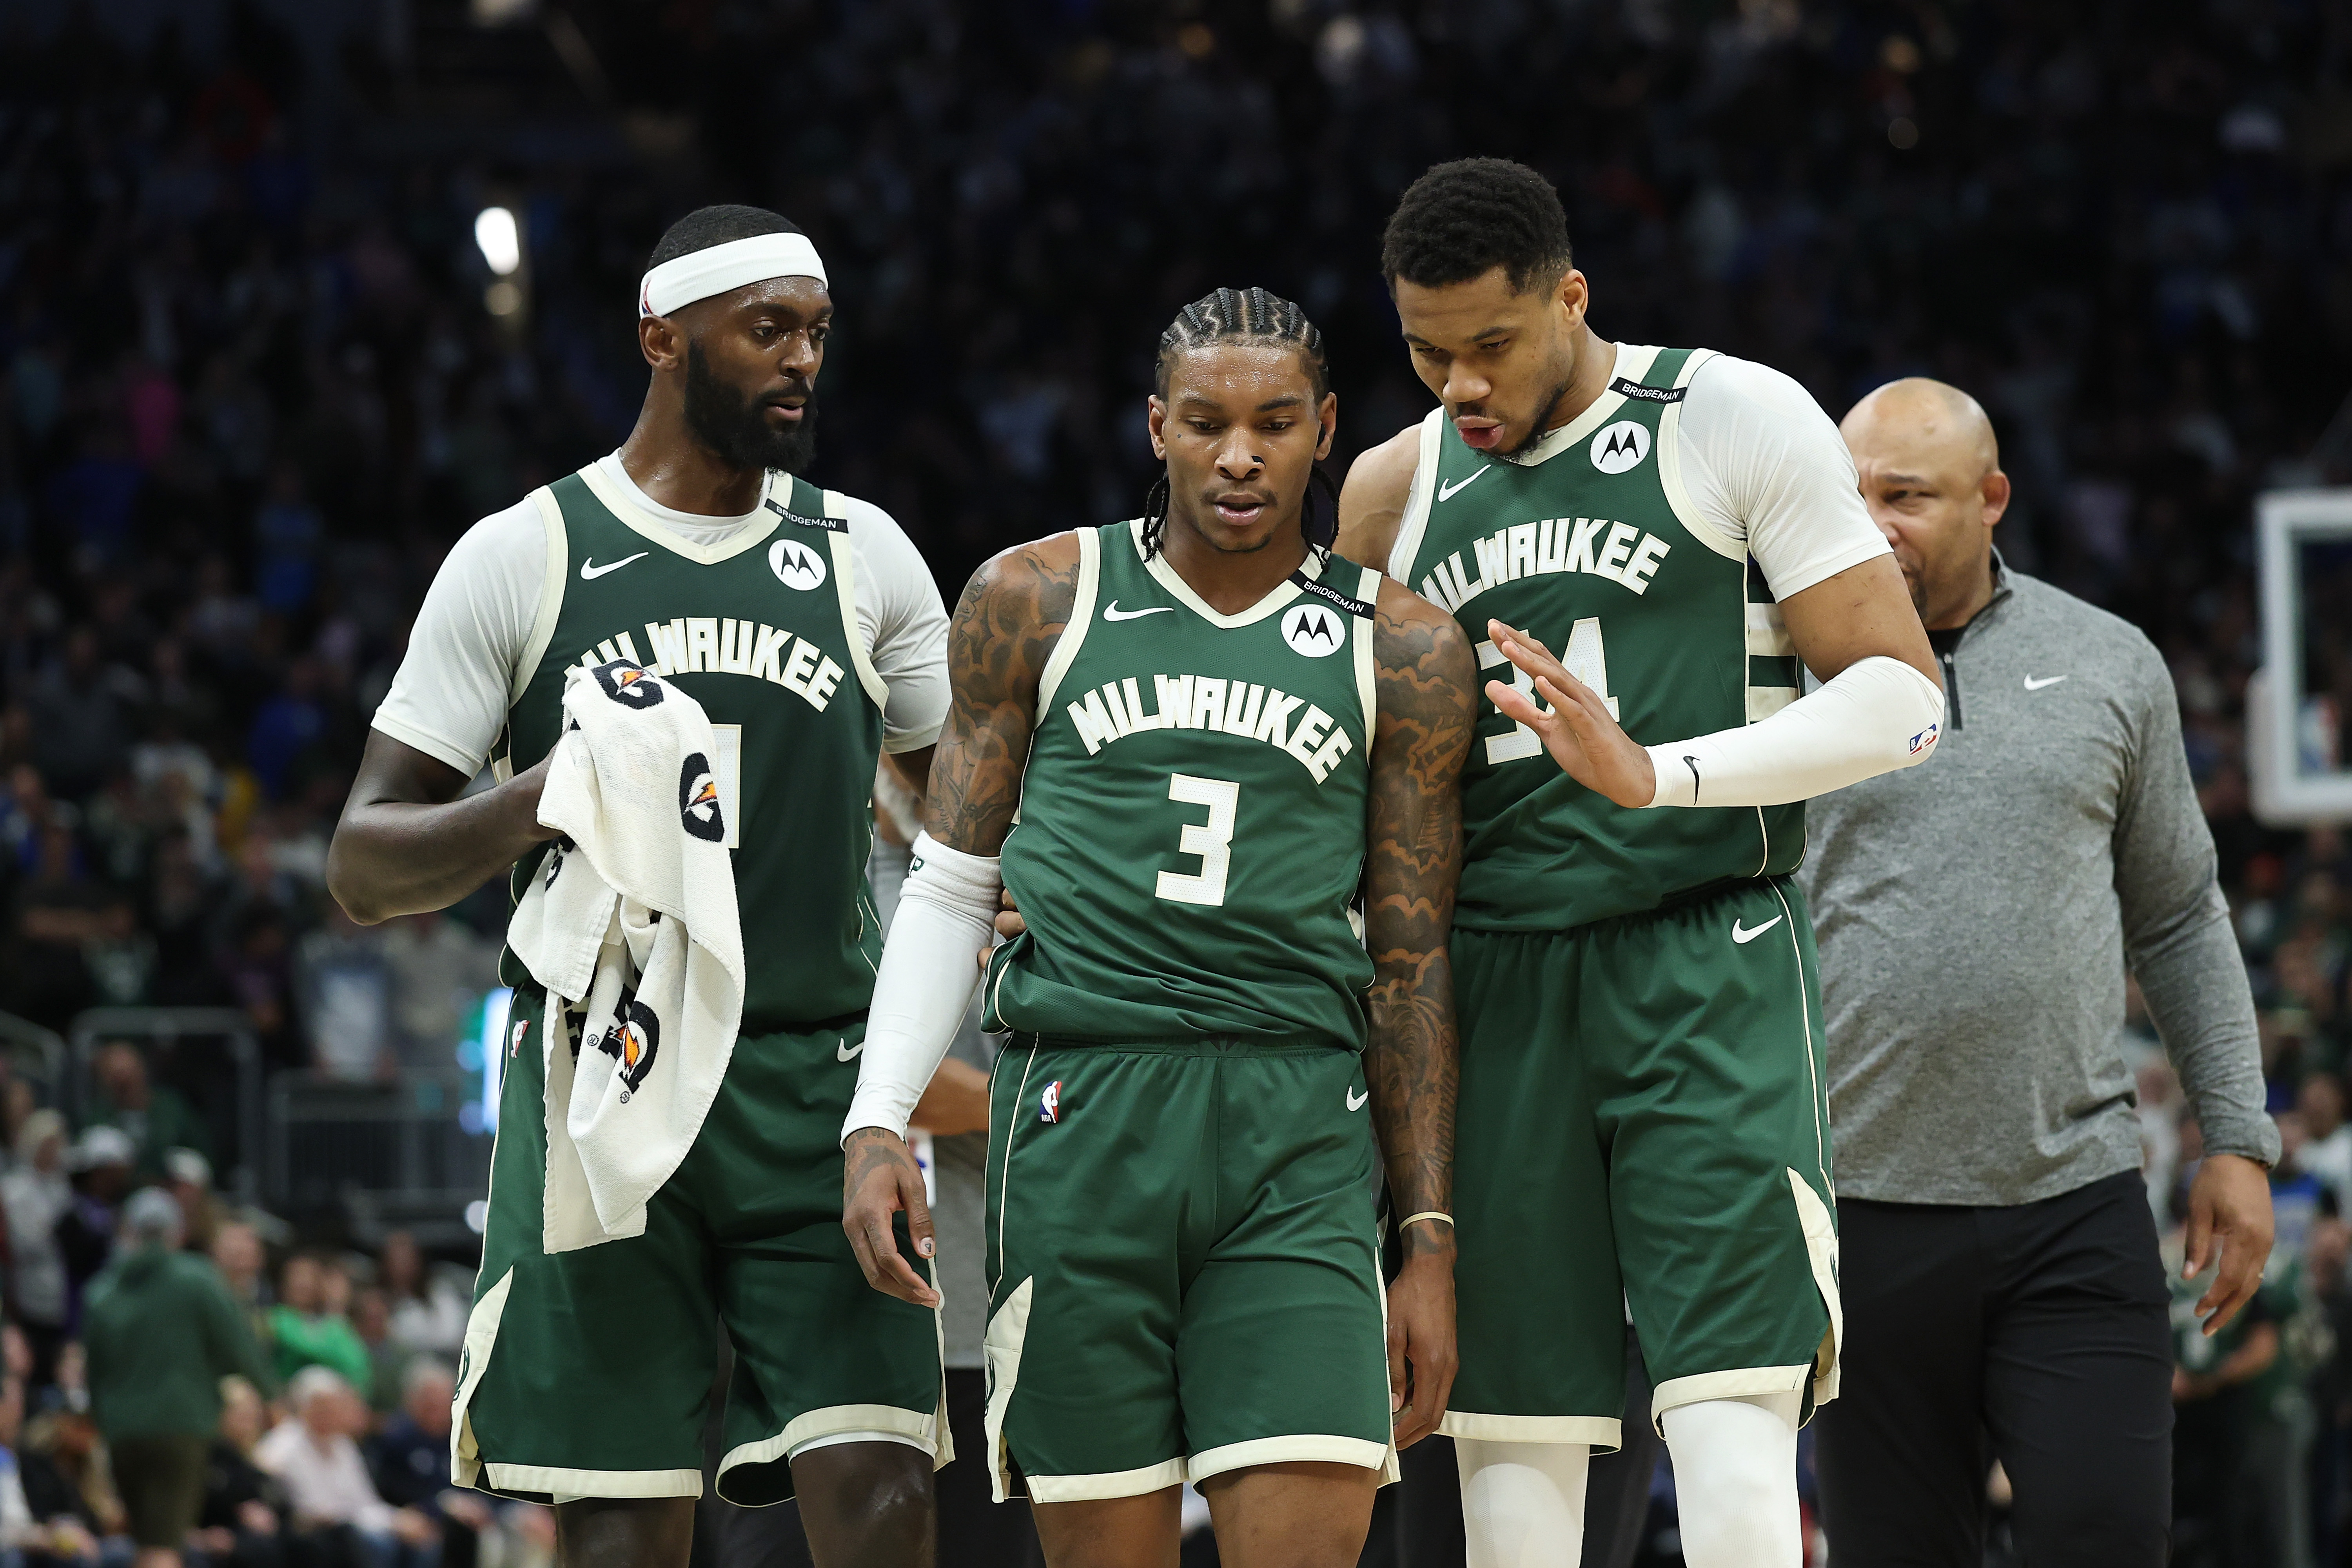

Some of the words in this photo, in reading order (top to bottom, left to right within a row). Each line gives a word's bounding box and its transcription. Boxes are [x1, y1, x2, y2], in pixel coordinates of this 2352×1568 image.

[1622, 383, 1679, 401] BRIDGEMAN
[776, 506, 837, 528] BRIDGEMAN
[1303, 581, 1364, 613] BRIDGEMAN
[1066, 674, 1353, 785] MILWAUKEE
[1155, 773, 1240, 906] 3
